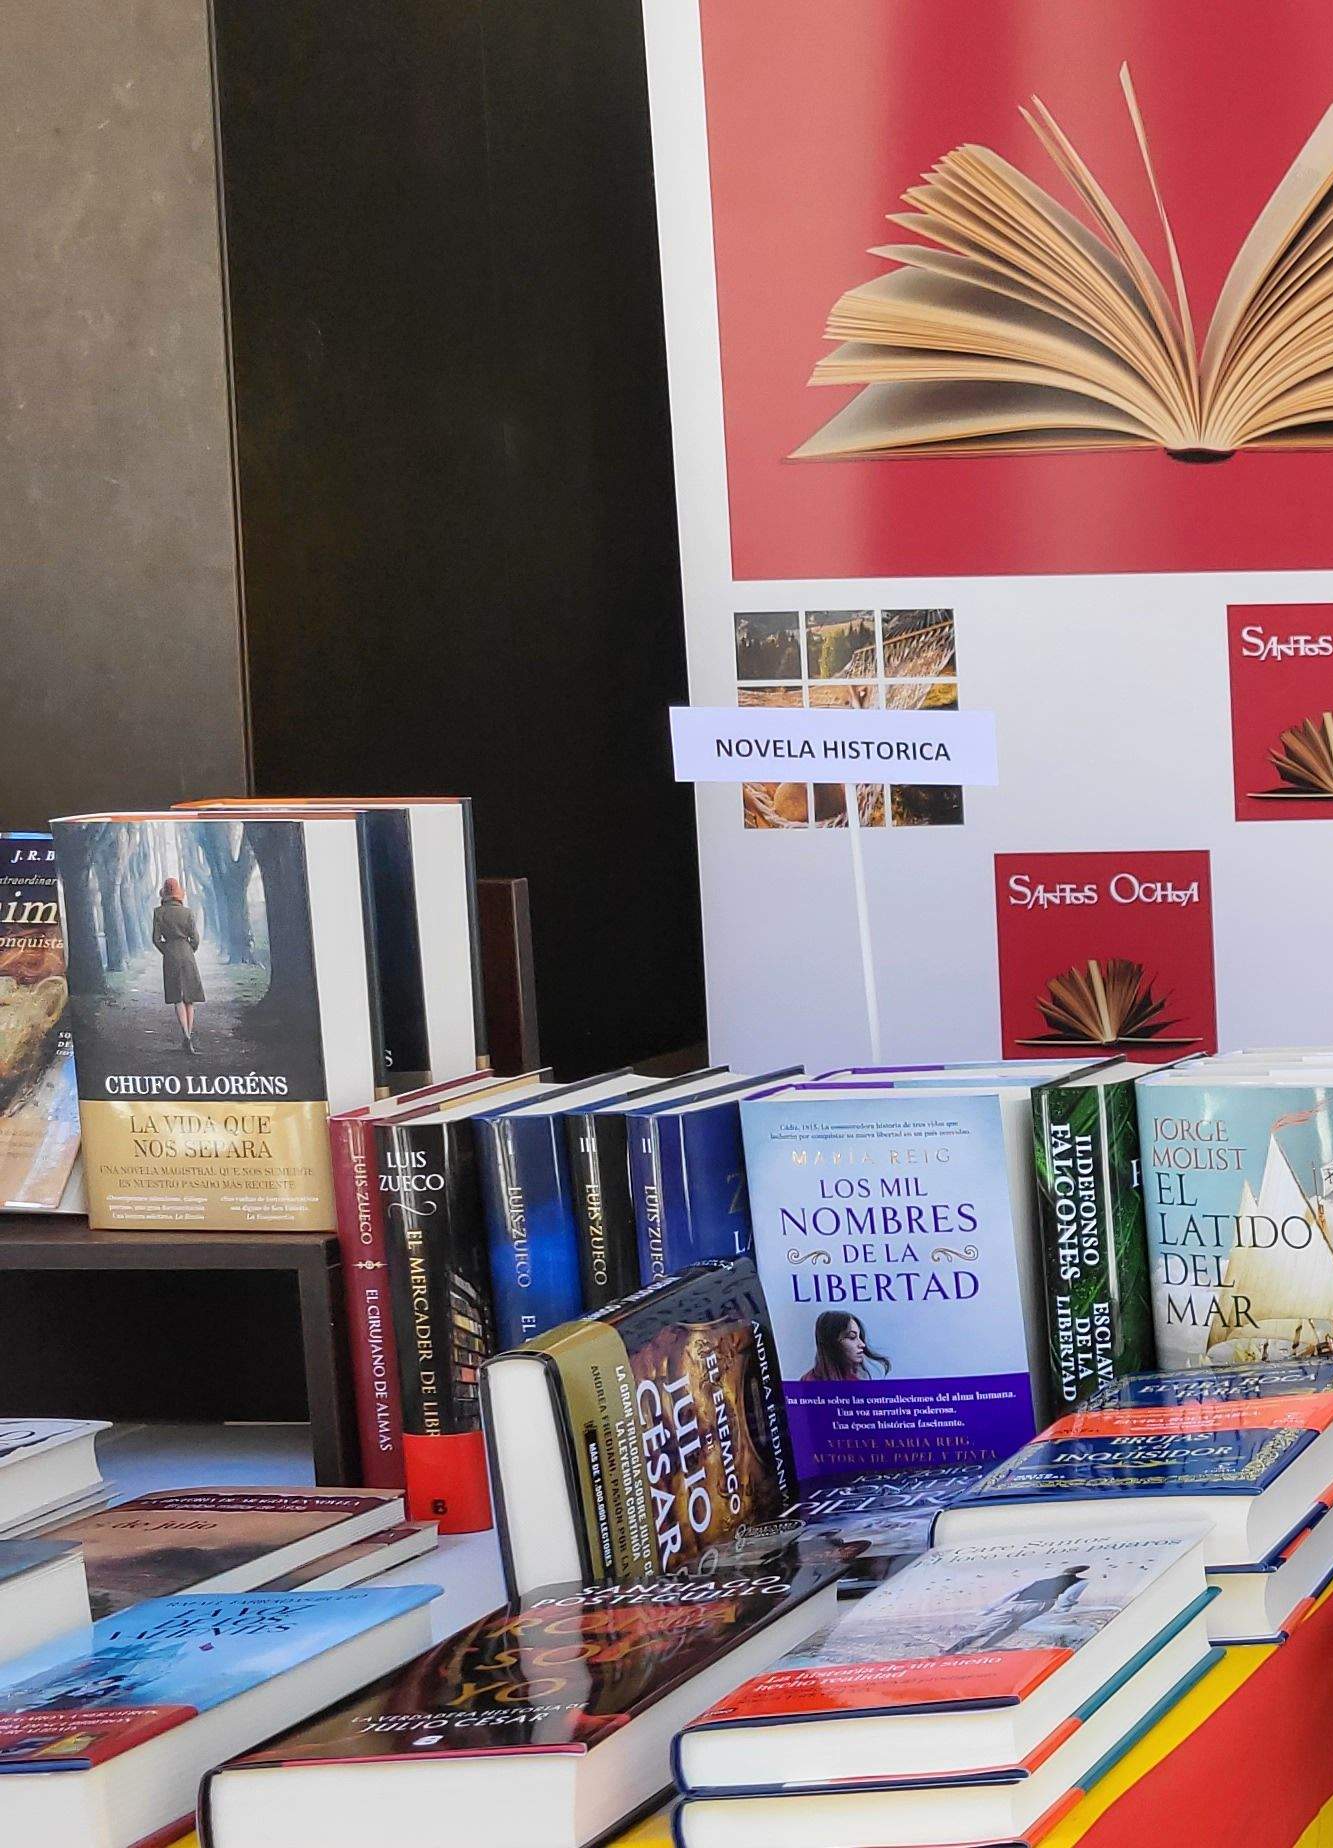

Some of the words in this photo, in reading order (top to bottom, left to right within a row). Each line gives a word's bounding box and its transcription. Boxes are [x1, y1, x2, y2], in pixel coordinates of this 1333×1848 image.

[716, 738, 816, 759] NOVELA
[823, 740, 951, 762] HISTORICA
[11, 850, 23, 864] J.
[27, 850, 41, 861] R.
[105, 1074, 181, 1095] CHUFO
[187, 1071, 289, 1096] LLORÉNS
[130, 1115, 159, 1134] LA
[163, 1115, 215, 1134] VIDA
[223, 1115, 272, 1135] QUE
[1153, 1117, 1229, 1142] JORGE
[134, 1139, 178, 1158] NOS
[184, 1139, 273, 1159] SEPARA
[386, 1151, 428, 1168] LUIS
[580, 1137, 597, 1154] III
[889, 1147, 951, 1165] REIG
[1152, 1146, 1248, 1171] MOLIST
[352, 1154, 369, 1187] LUIS
[378, 1173, 445, 1192] ZUECO
[820, 1178, 871, 1199] LOS
[880, 1177, 928, 1198] MIL
[1050, 1123, 1081, 1282] FALCONES
[1075, 1135, 1100, 1267] ILDEFONSO
[1155, 1171, 1198, 1207] EL
[356, 1190, 373, 1245] ZUECO
[507, 1187, 526, 1223] LUIS
[585, 1184, 603, 1224] LUIS
[644, 1185, 662, 1222] LUIS
[779, 1203, 979, 1236] NOMBRES
[1158, 1212, 1313, 1250] LATIDO
[406, 1230, 423, 1250] EL
[842, 1244, 877, 1263] DE
[884, 1243, 920, 1262] LA
[511, 1227, 531, 1288] ZUECO
[589, 1225, 608, 1286] ZUECO
[1161, 1251, 1236, 1288] DEL
[365, 1289, 379, 1305] EL
[791, 1270, 980, 1303] LIBERTAD
[409, 1257, 434, 1362] MERCADER
[1166, 1293, 1260, 1329] MAR
[367, 1305, 387, 1378] CIRUJANO
[1075, 1317, 1091, 1347] DE
[751, 1319, 773, 1400] ANDREA
[1056, 1296, 1078, 1402] LIBERTAD
[615, 1365, 625, 1381] LA
[705, 1352, 720, 1383] EL
[1077, 1352, 1094, 1380] LA
[373, 1380, 388, 1400] DE
[420, 1371, 437, 1395] DE
[800, 1396, 825, 1405] novela
[827, 1395, 851, 1405] sobre
[852, 1394, 864, 1404] las
[866, 1392, 935, 1404] contradicciones
[936, 1391, 950, 1402] del
[952, 1391, 975, 1401] alma
[976, 1390, 1017, 1400] humana.
[619, 1384, 633, 1417] GRAN
[837, 1407, 854, 1417] Una
[855, 1409, 871, 1417] voz
[872, 1406, 911, 1416] narrativa
[913, 1406, 957, 1417] poderosa.
[376, 1402, 394, 1452] ALMAS
[615, 1421, 625, 1437] LA
[832, 1420, 849, 1430] Una
[851, 1420, 876, 1432] época
[877, 1418, 916, 1430] histórica
[917, 1417, 965, 1428] fascinante.
[1111, 1432, 1216, 1447] BRUJAS
[625, 1421, 642, 1477] TRILOGÍA
[663, 1374, 713, 1534] JULIO
[712, 1390, 742, 1515] ENEMIGO
[1052, 1445, 1234, 1463] INQUISIDOR
[618, 1440, 633, 1495] LEYENDA
[636, 1379, 683, 1572] CÉSAR
[634, 1480, 648, 1521] SOBRE
[601, 1522, 612, 1567] LECTORES
[624, 1498, 641, 1561] CONTINÚA
[639, 1523, 652, 1559] JULIO
[530, 1583, 794, 1609] POSTEGUILLO
[581, 1575, 783, 1597] SANTIAGO
[447, 1677, 568, 1707] YO
[359, 1718, 449, 1734] JULIO
[378, 1710, 477, 1723] VERDADERA
[478, 1705, 563, 1718] HISTORIA
